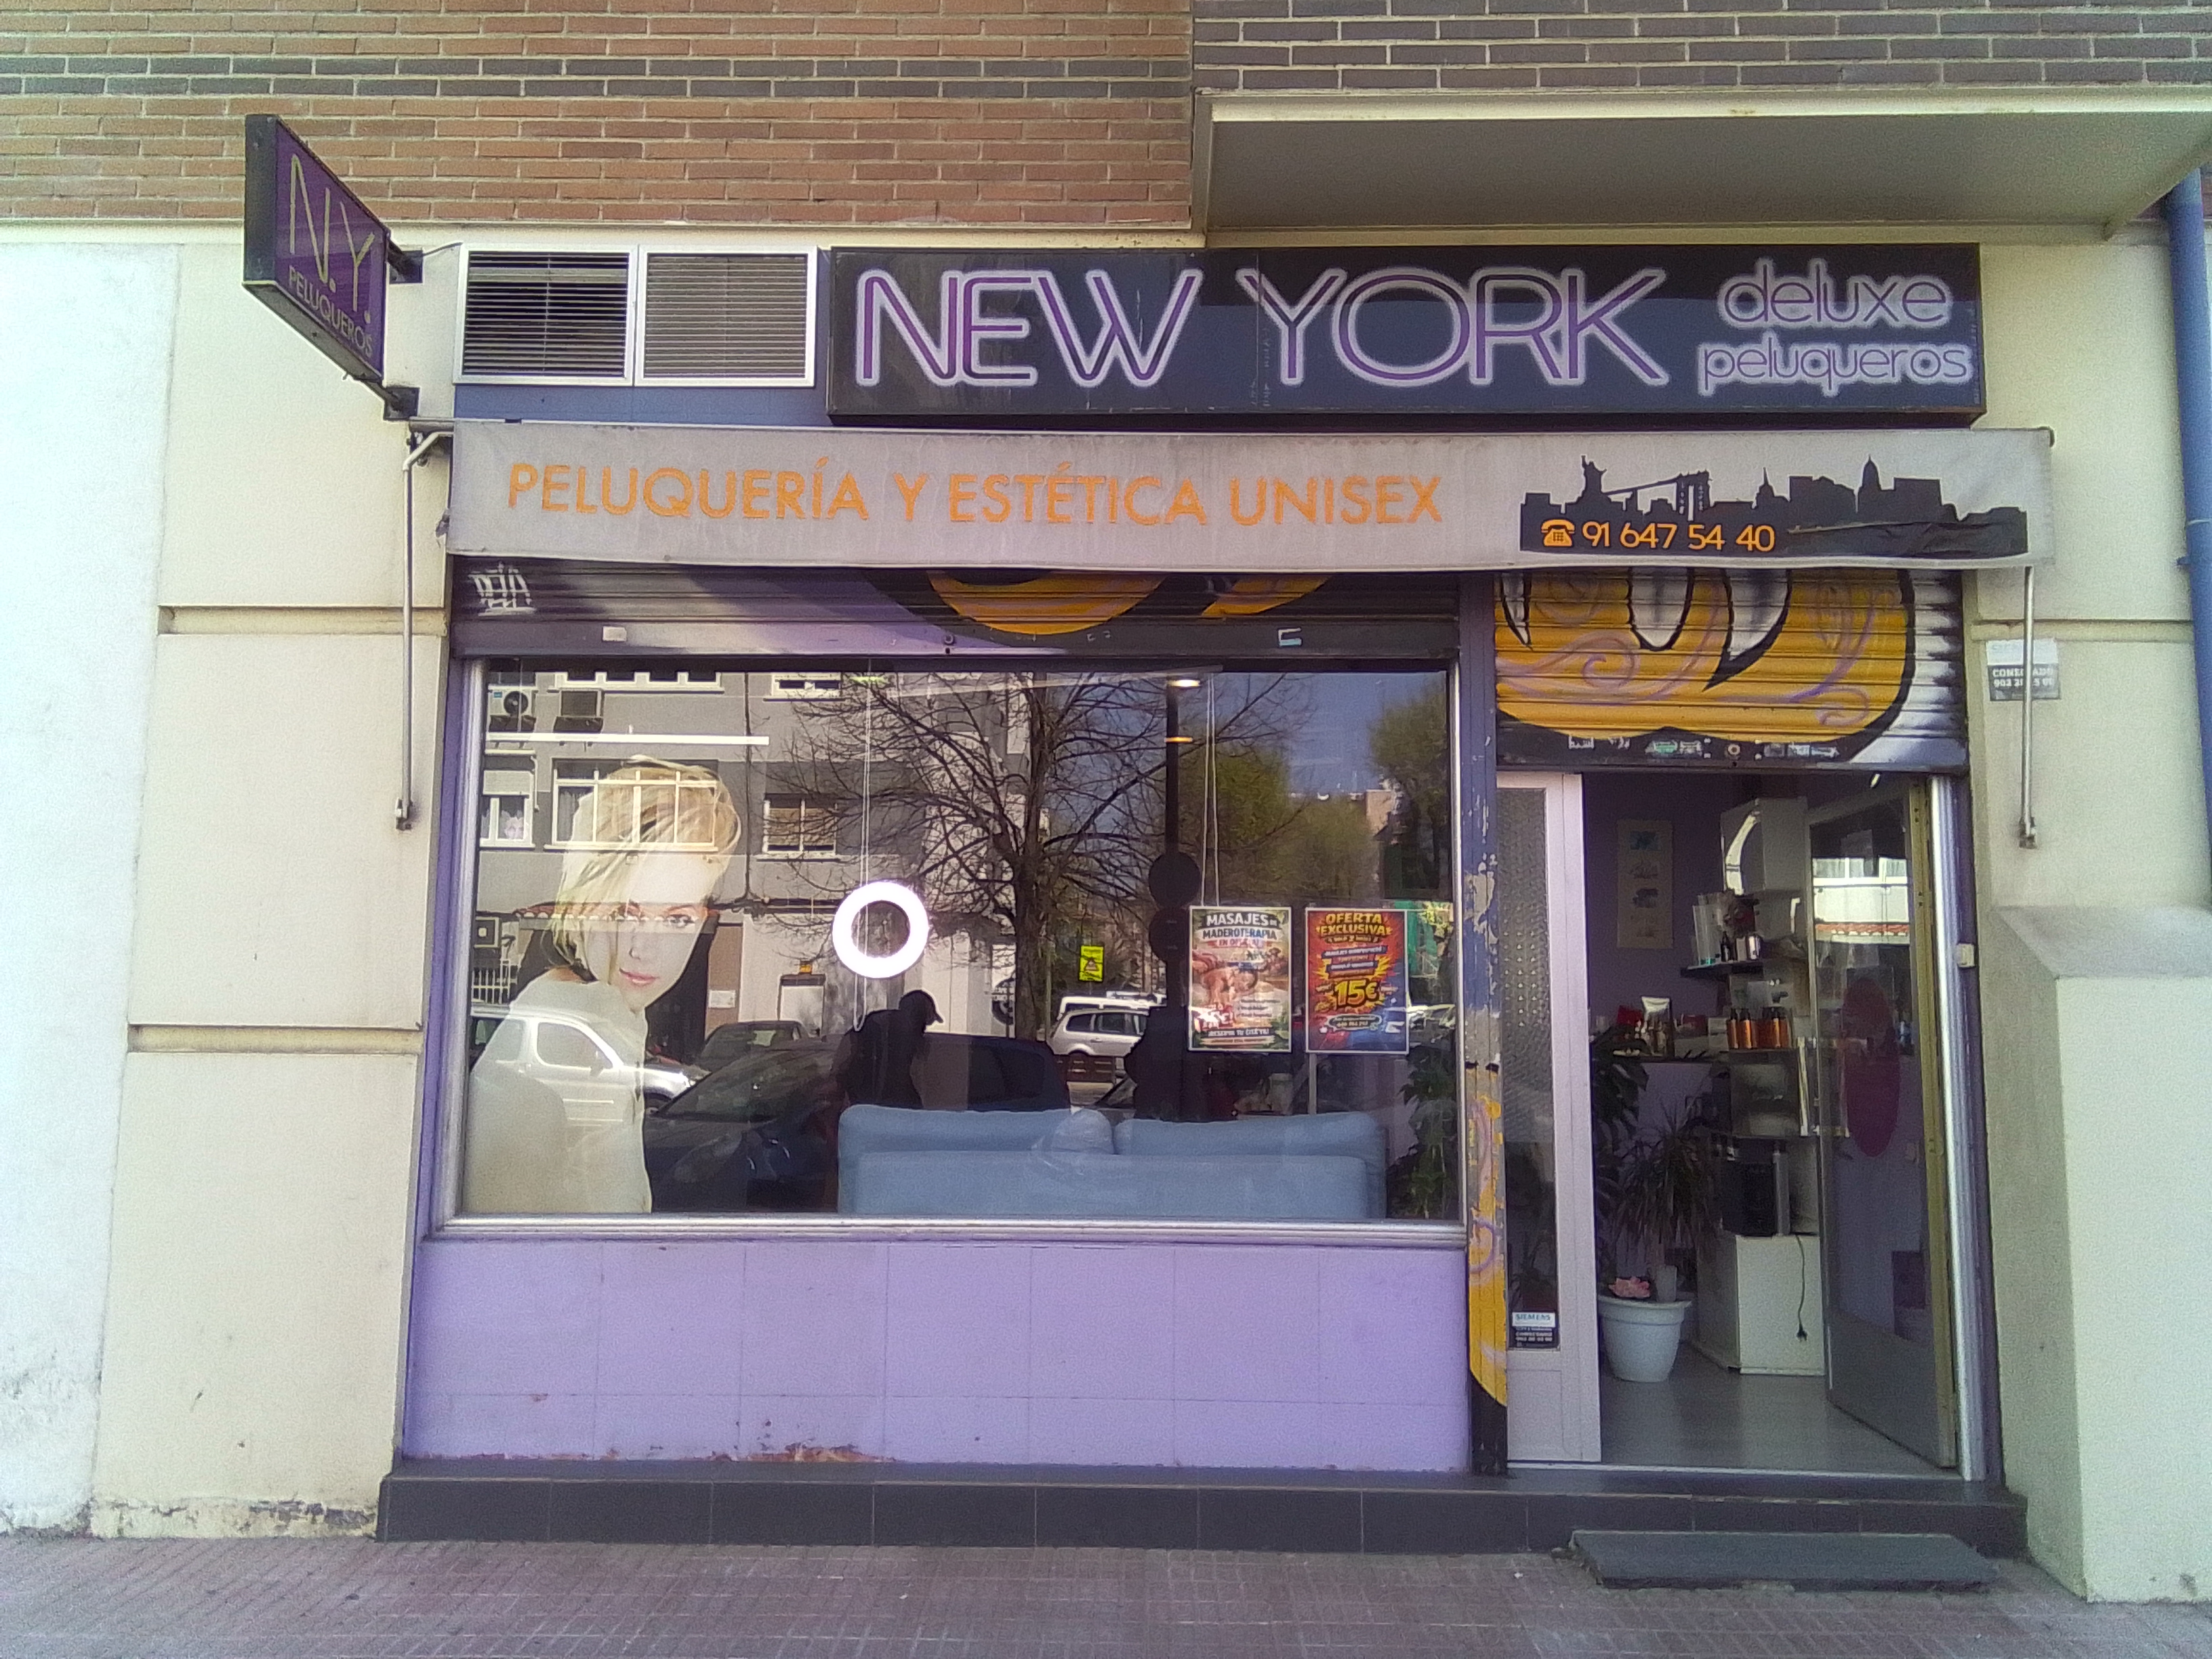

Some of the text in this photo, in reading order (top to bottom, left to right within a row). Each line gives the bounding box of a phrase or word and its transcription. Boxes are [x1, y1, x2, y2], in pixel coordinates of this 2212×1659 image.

[1717, 256, 1953, 329] deluxe
[288, 265, 374, 358] PELUQUEROS
[856, 266, 1671, 388] NEW YORK
[1697, 330, 1974, 397] peluqueros
[507, 455, 1443, 527] PELUQUERÍA Y ESTÉTICA UNISEX
[1581, 520, 1776, 552] 91 647 54 40
[1202, 928, 1277, 940] MADEROTERAPIA
[1206, 912, 1269, 926] MASAJES
[1320, 924, 1386, 936] EXCLUSIVA
[1326, 912, 1382, 925] OFERTA
[1334, 979, 1378, 1006] 15€
